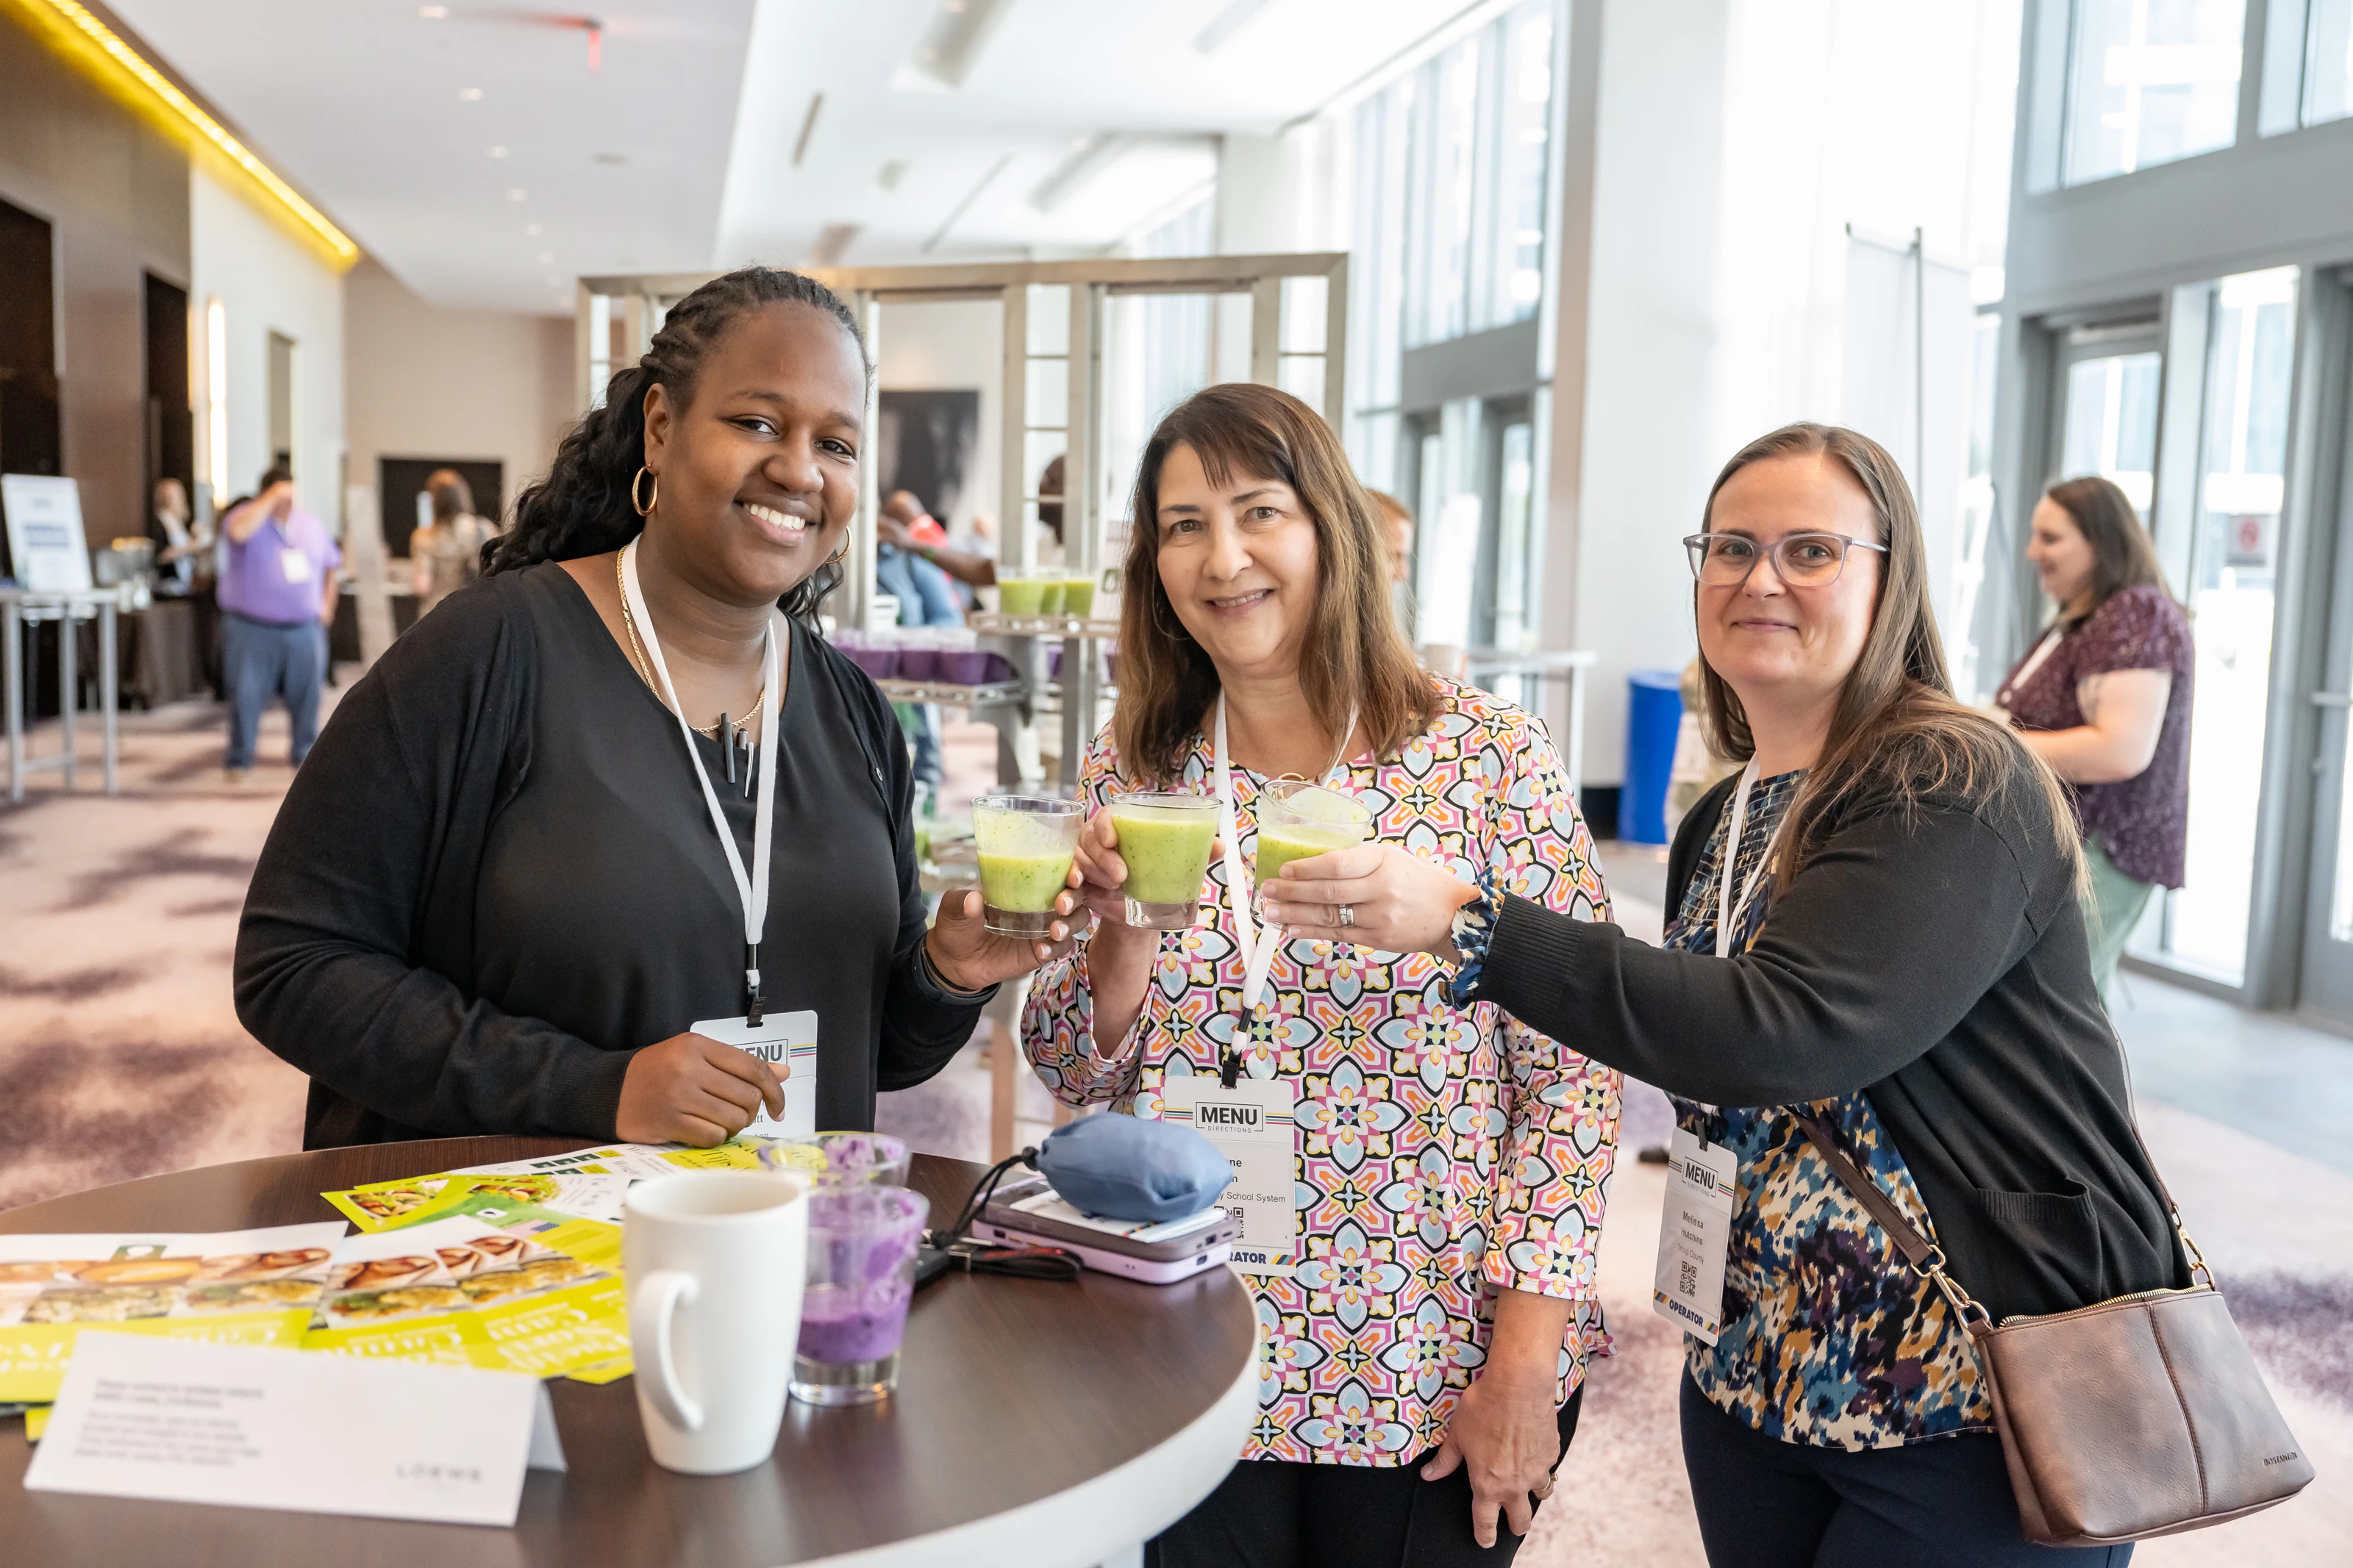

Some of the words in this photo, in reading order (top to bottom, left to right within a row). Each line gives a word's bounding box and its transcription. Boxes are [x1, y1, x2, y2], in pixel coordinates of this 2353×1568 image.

[1201, 1106, 1257, 1125] MENU
[1207, 1125, 1252, 1134] DIRECTIONS
[1685, 1161, 1715, 1190] MENU
[1227, 1191, 1254, 1201] School
[1256, 1193, 1286, 1203] System
[1687, 1181, 1710, 1198] DIRECTIONS
[1682, 1210, 1704, 1229] Melissa
[1680, 1226, 1704, 1245] Hutchins
[1677, 1242, 1690, 1256] Troup
[1689, 1250, 1704, 1265] County
[1668, 1299, 1704, 1328] OPERATOR
